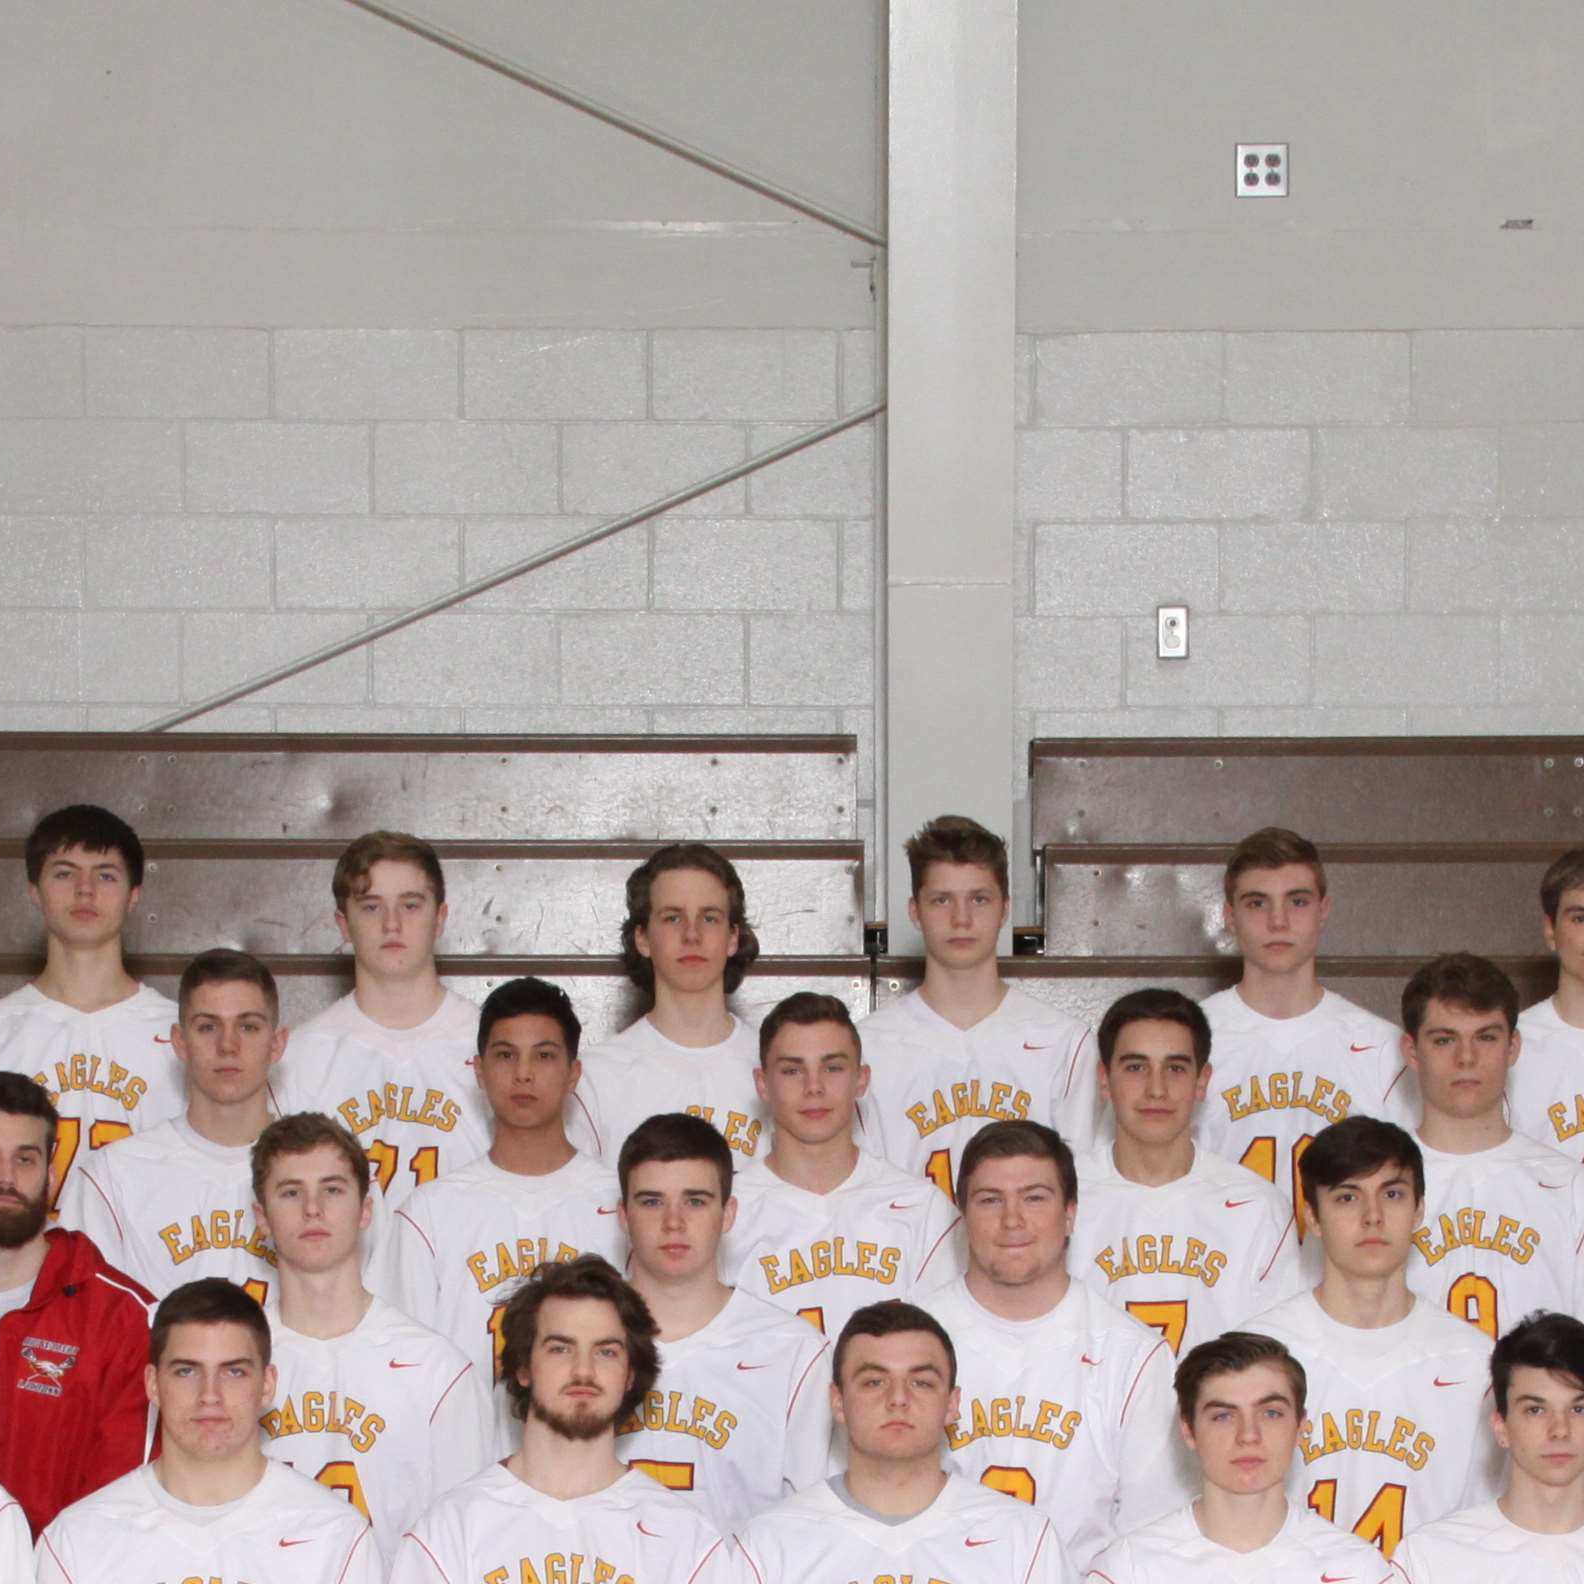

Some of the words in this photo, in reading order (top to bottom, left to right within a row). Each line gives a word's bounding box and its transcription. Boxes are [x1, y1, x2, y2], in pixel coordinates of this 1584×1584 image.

[338, 1082, 462, 1135] EAGLES
[906, 1079, 1033, 1139] EAGLES
[1222, 1071, 1353, 1122] EAGLES
[159, 1209, 278, 1266] EAGLE
[1096, 1235, 1228, 1289] EAGLES
[1414, 1207, 1541, 1264] EAGLES
[759, 1236, 902, 1294] EAGLES
[616, 1390, 738, 1450] AGLES
[944, 1395, 1082, 1451] EAGLES
[1297, 1408, 1435, 1471] EAGLES
